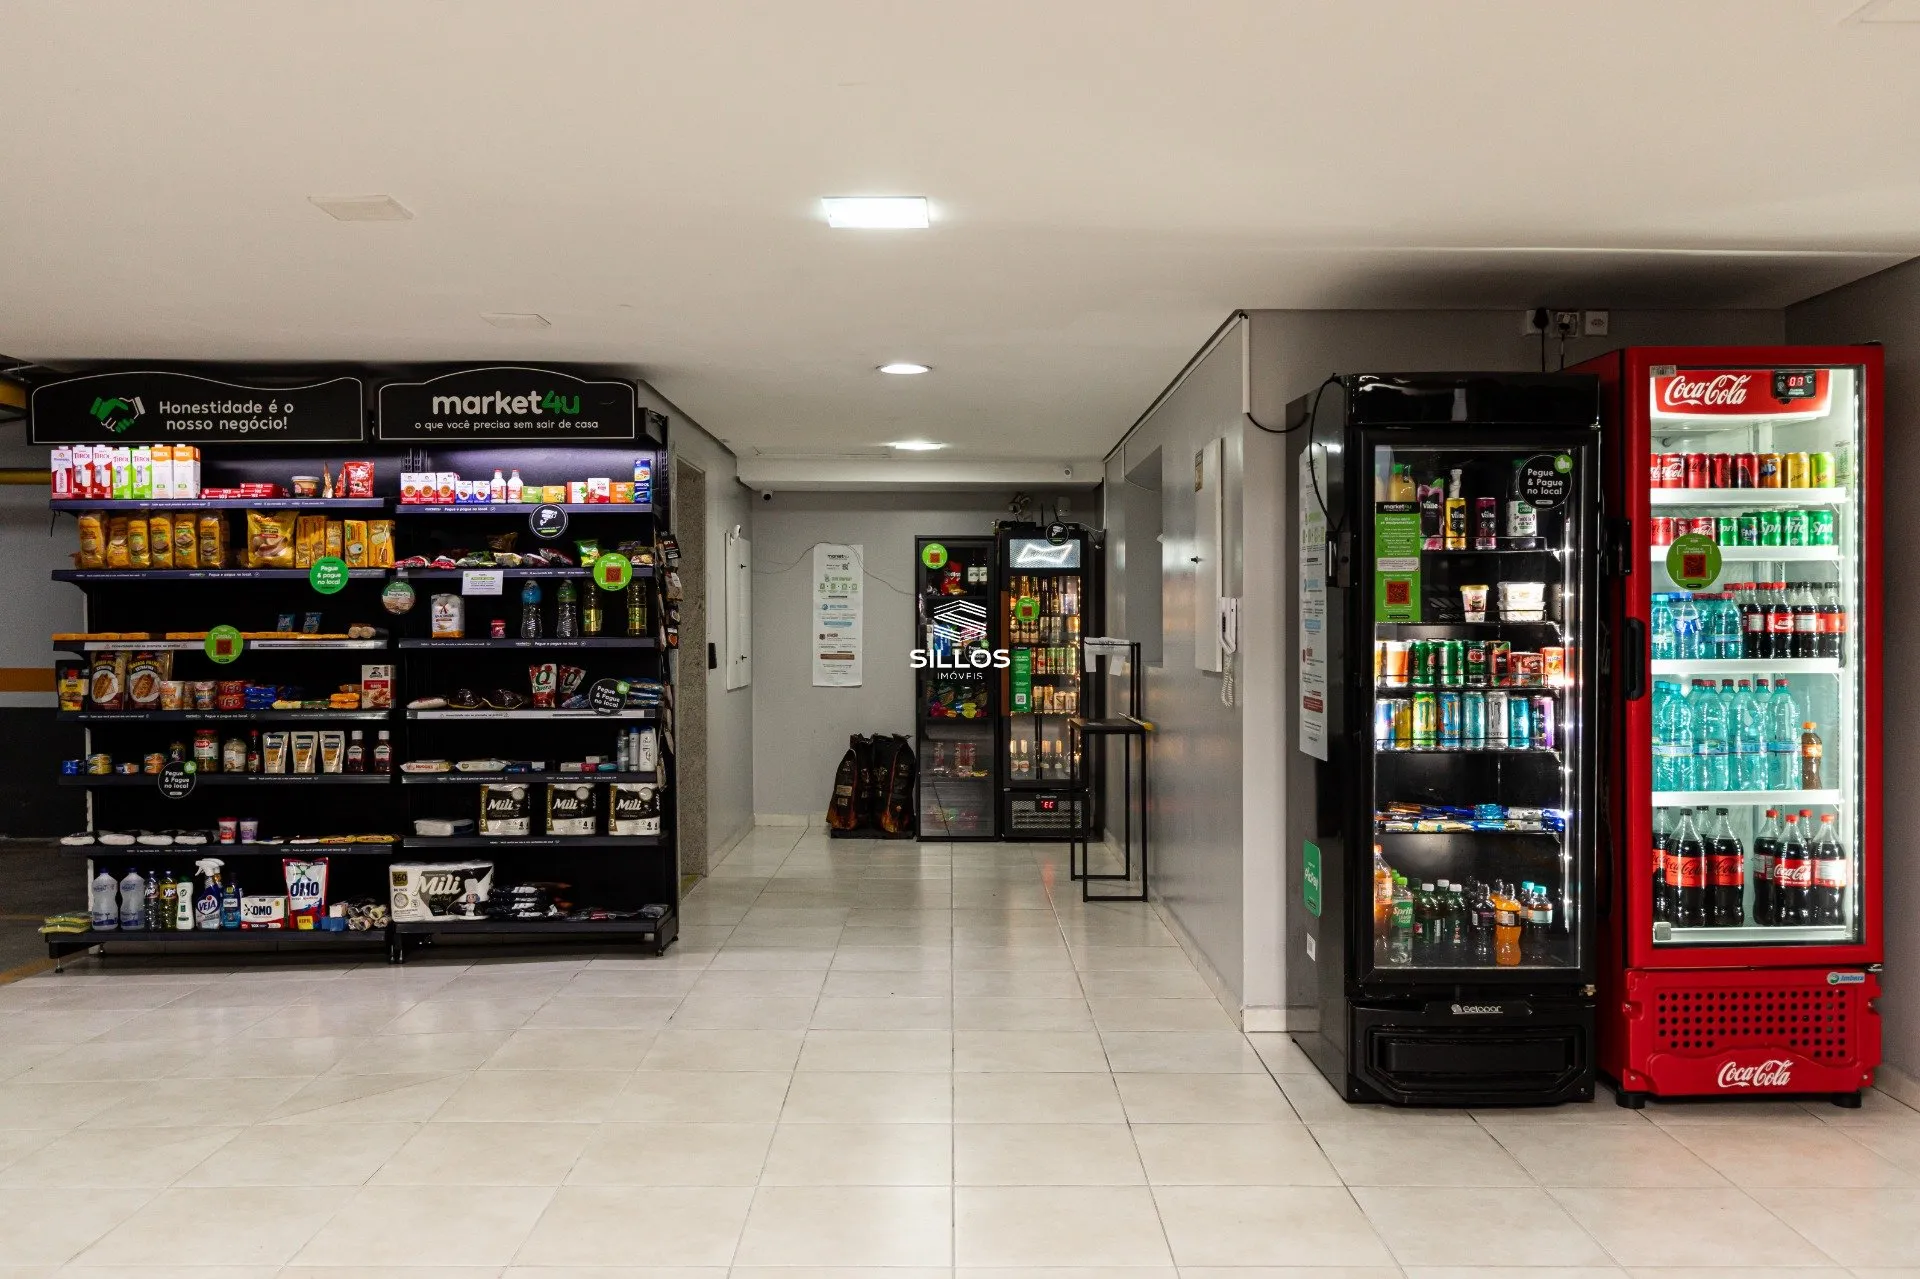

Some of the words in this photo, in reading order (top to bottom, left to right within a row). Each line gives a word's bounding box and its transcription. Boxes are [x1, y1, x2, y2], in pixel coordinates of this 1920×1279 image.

[1664, 374, 1752, 406] Coca-Cola
[160, 399, 262, 414] Honestidade
[269, 399, 278, 414] é
[284, 403, 294, 414] o
[432, 390, 580, 414] market4u
[167, 420, 213, 430] nosso
[220, 416, 287, 434] negócio!
[425, 422, 444, 431] que
[447, 419, 470, 429] você
[473, 420, 510, 431] precisa
[513, 421, 533, 429] sem
[536, 419, 555, 429] sair
[558, 419, 571, 429] de
[574, 421, 599, 429] casa
[1527, 468, 1554, 478] Pegue
[1527, 478, 1534, 486] &
[1536, 478, 1563, 487] Pague
[1541, 487, 1562, 495] local
[597, 685, 616, 694] Pegue
[487, 799, 514, 811] Mili
[553, 798, 579, 810] Mili
[616, 798, 642, 811] Mili
[290, 881, 319, 897] OMO
[412, 874, 461, 896] Mili
[198, 898, 218, 912] VEJA
[252, 905, 272, 916] OMO
[1717, 1059, 1794, 1088] Coca-Cola
